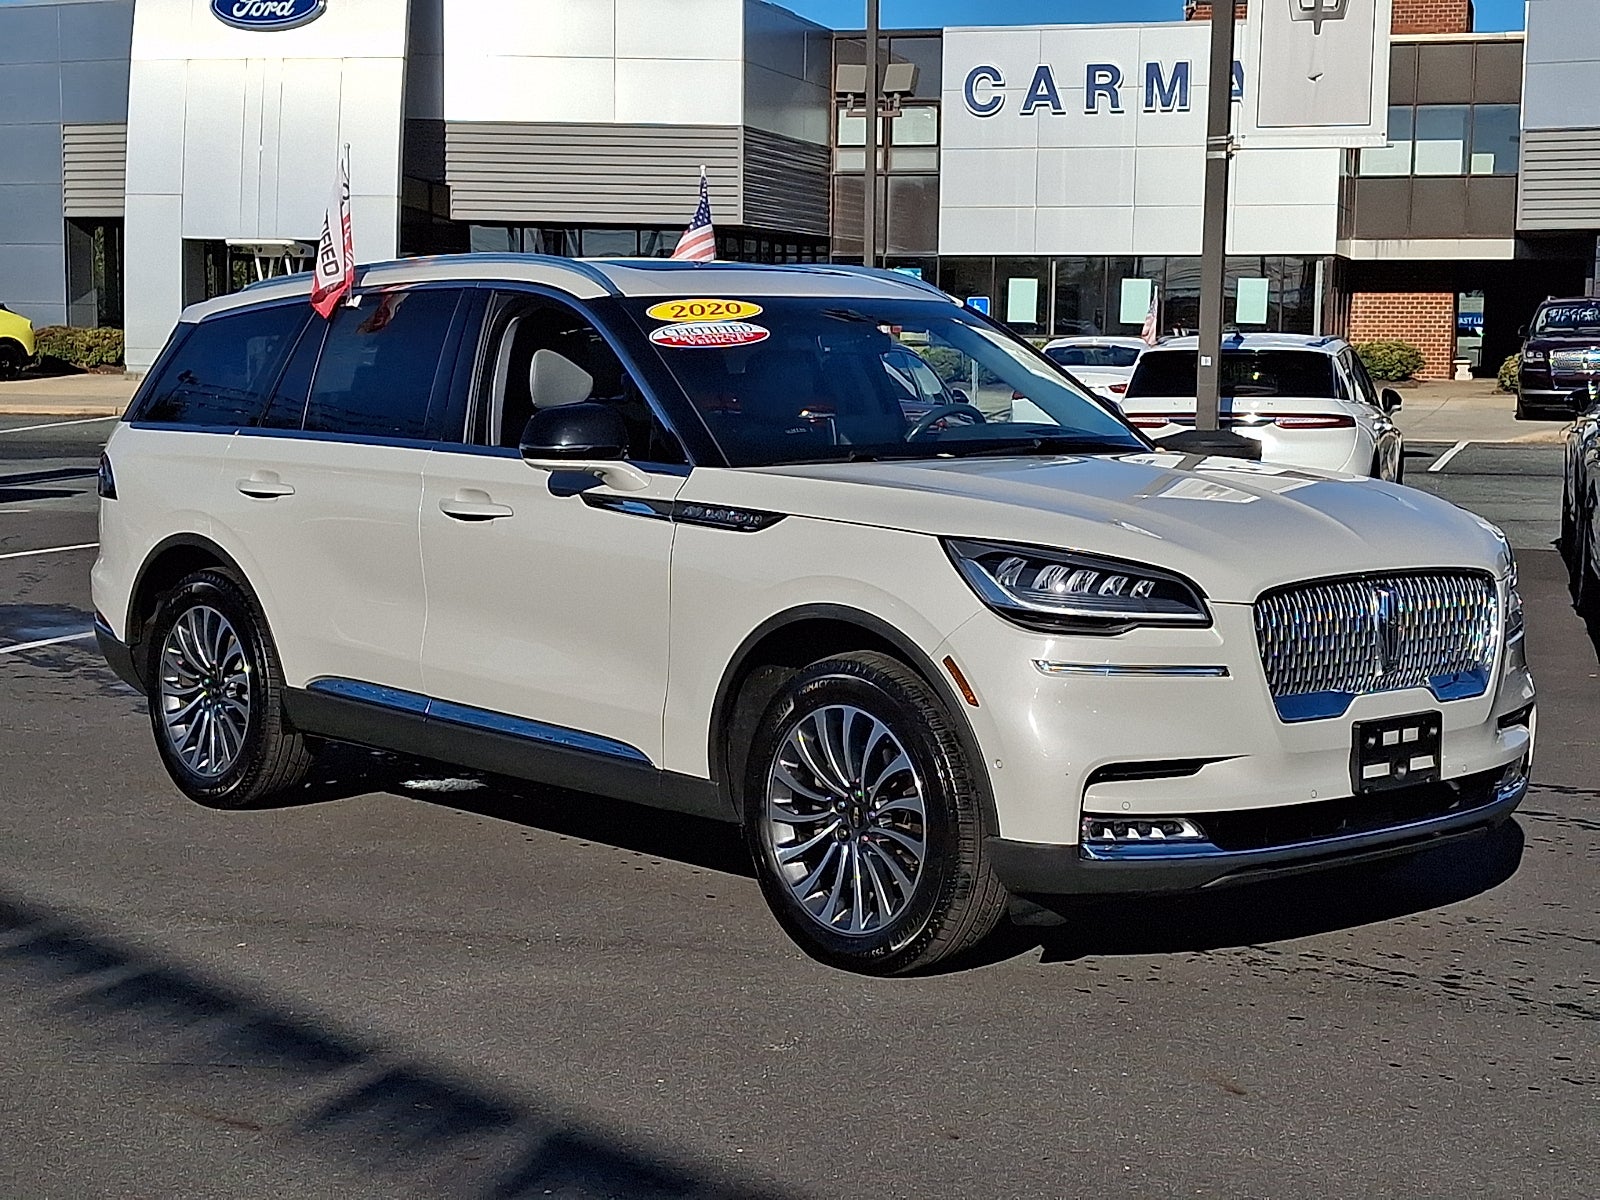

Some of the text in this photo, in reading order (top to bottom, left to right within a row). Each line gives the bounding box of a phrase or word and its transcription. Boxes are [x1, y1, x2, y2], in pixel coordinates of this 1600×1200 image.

[232, 0, 295, 17] Ford
[963, 60, 1244, 117] CARM
[670, 302, 742, 318] 2020
[662, 323, 754, 337] CERTIFIED
